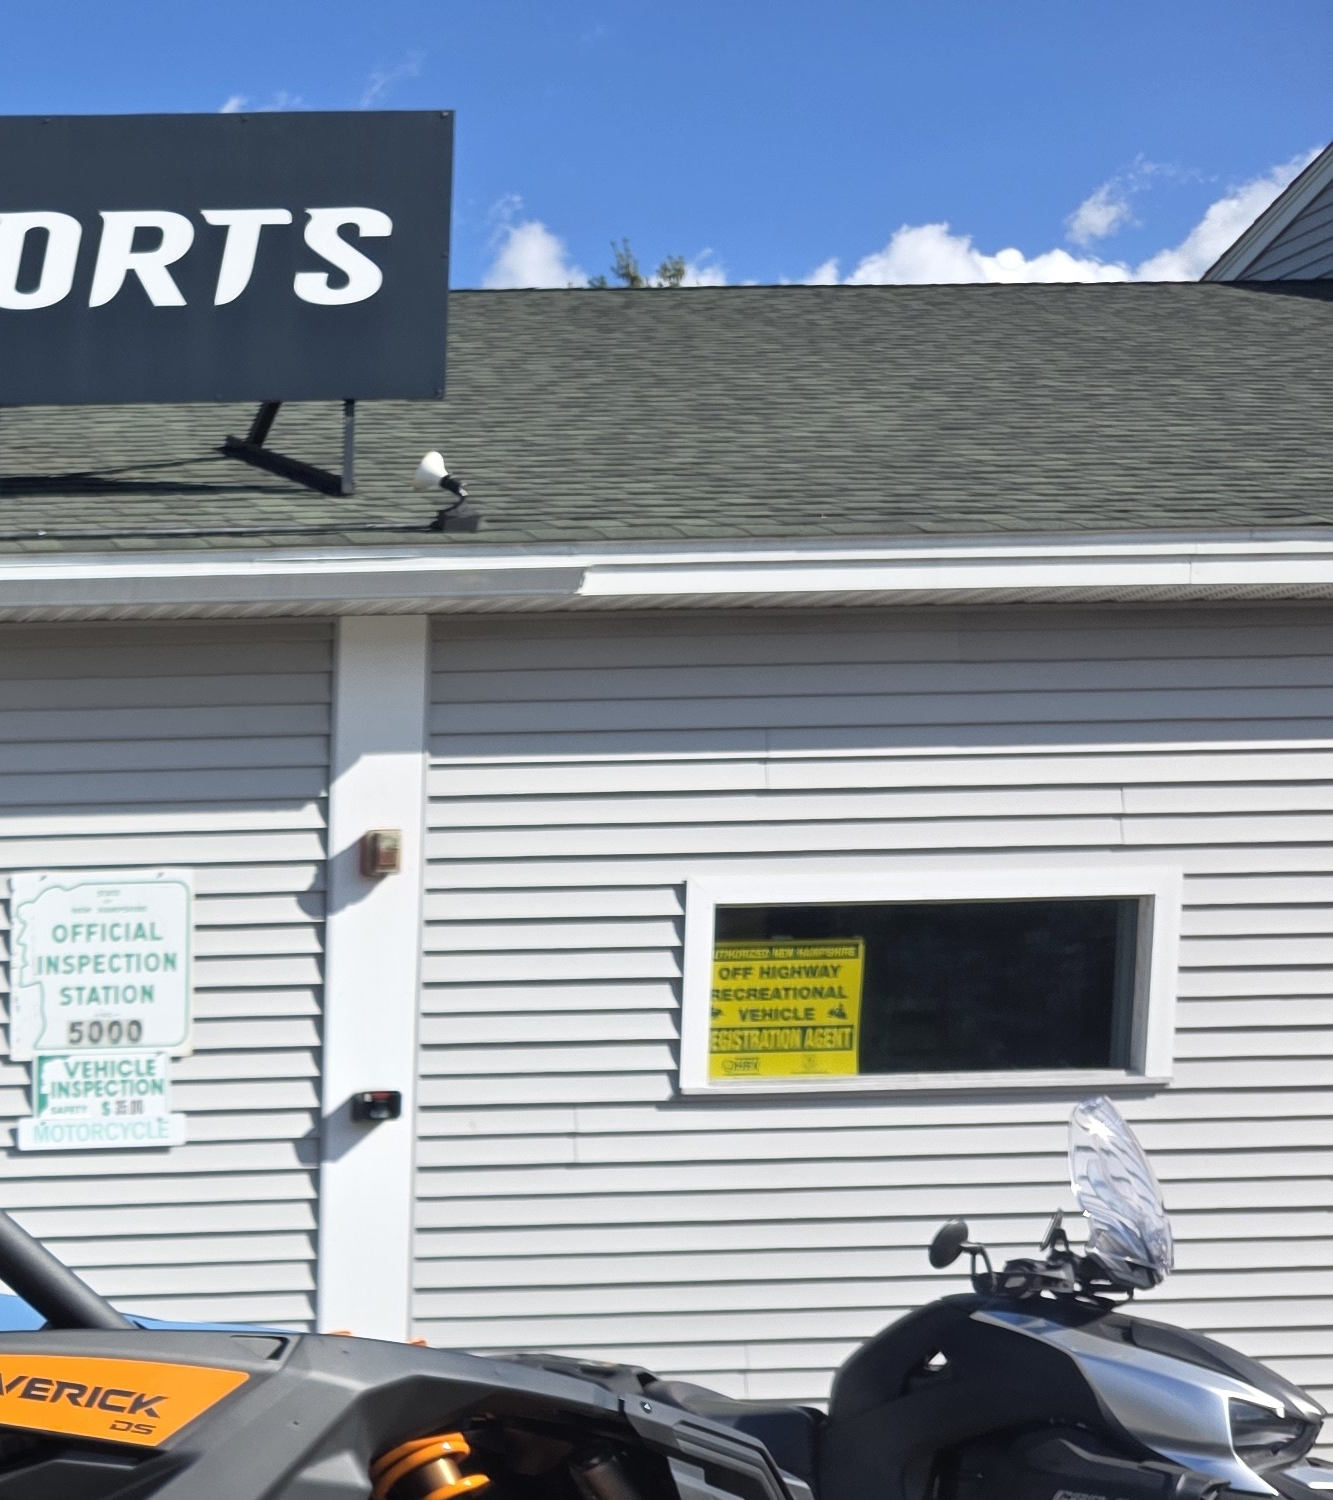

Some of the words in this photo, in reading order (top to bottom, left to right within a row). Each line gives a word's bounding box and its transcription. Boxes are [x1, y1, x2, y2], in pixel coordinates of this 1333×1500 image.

[51, 922, 163, 943] OFFICIAL
[37, 952, 177, 975] INSPECTION
[719, 967, 753, 980] OFF
[759, 964, 842, 979] HIGHWAY
[59, 984, 155, 1006] STATION
[739, 1007, 815, 1022] VEHICLE
[68, 1019, 142, 1044] 5000
[711, 1028, 802, 1051] EGISTRATION
[63, 1059, 157, 1079] VEHICLE
[51, 1078, 164, 1099] INSPECTION
[33, 1119, 170, 1143] MOTORCYCLE
[109, 1420, 156, 1435] DS
